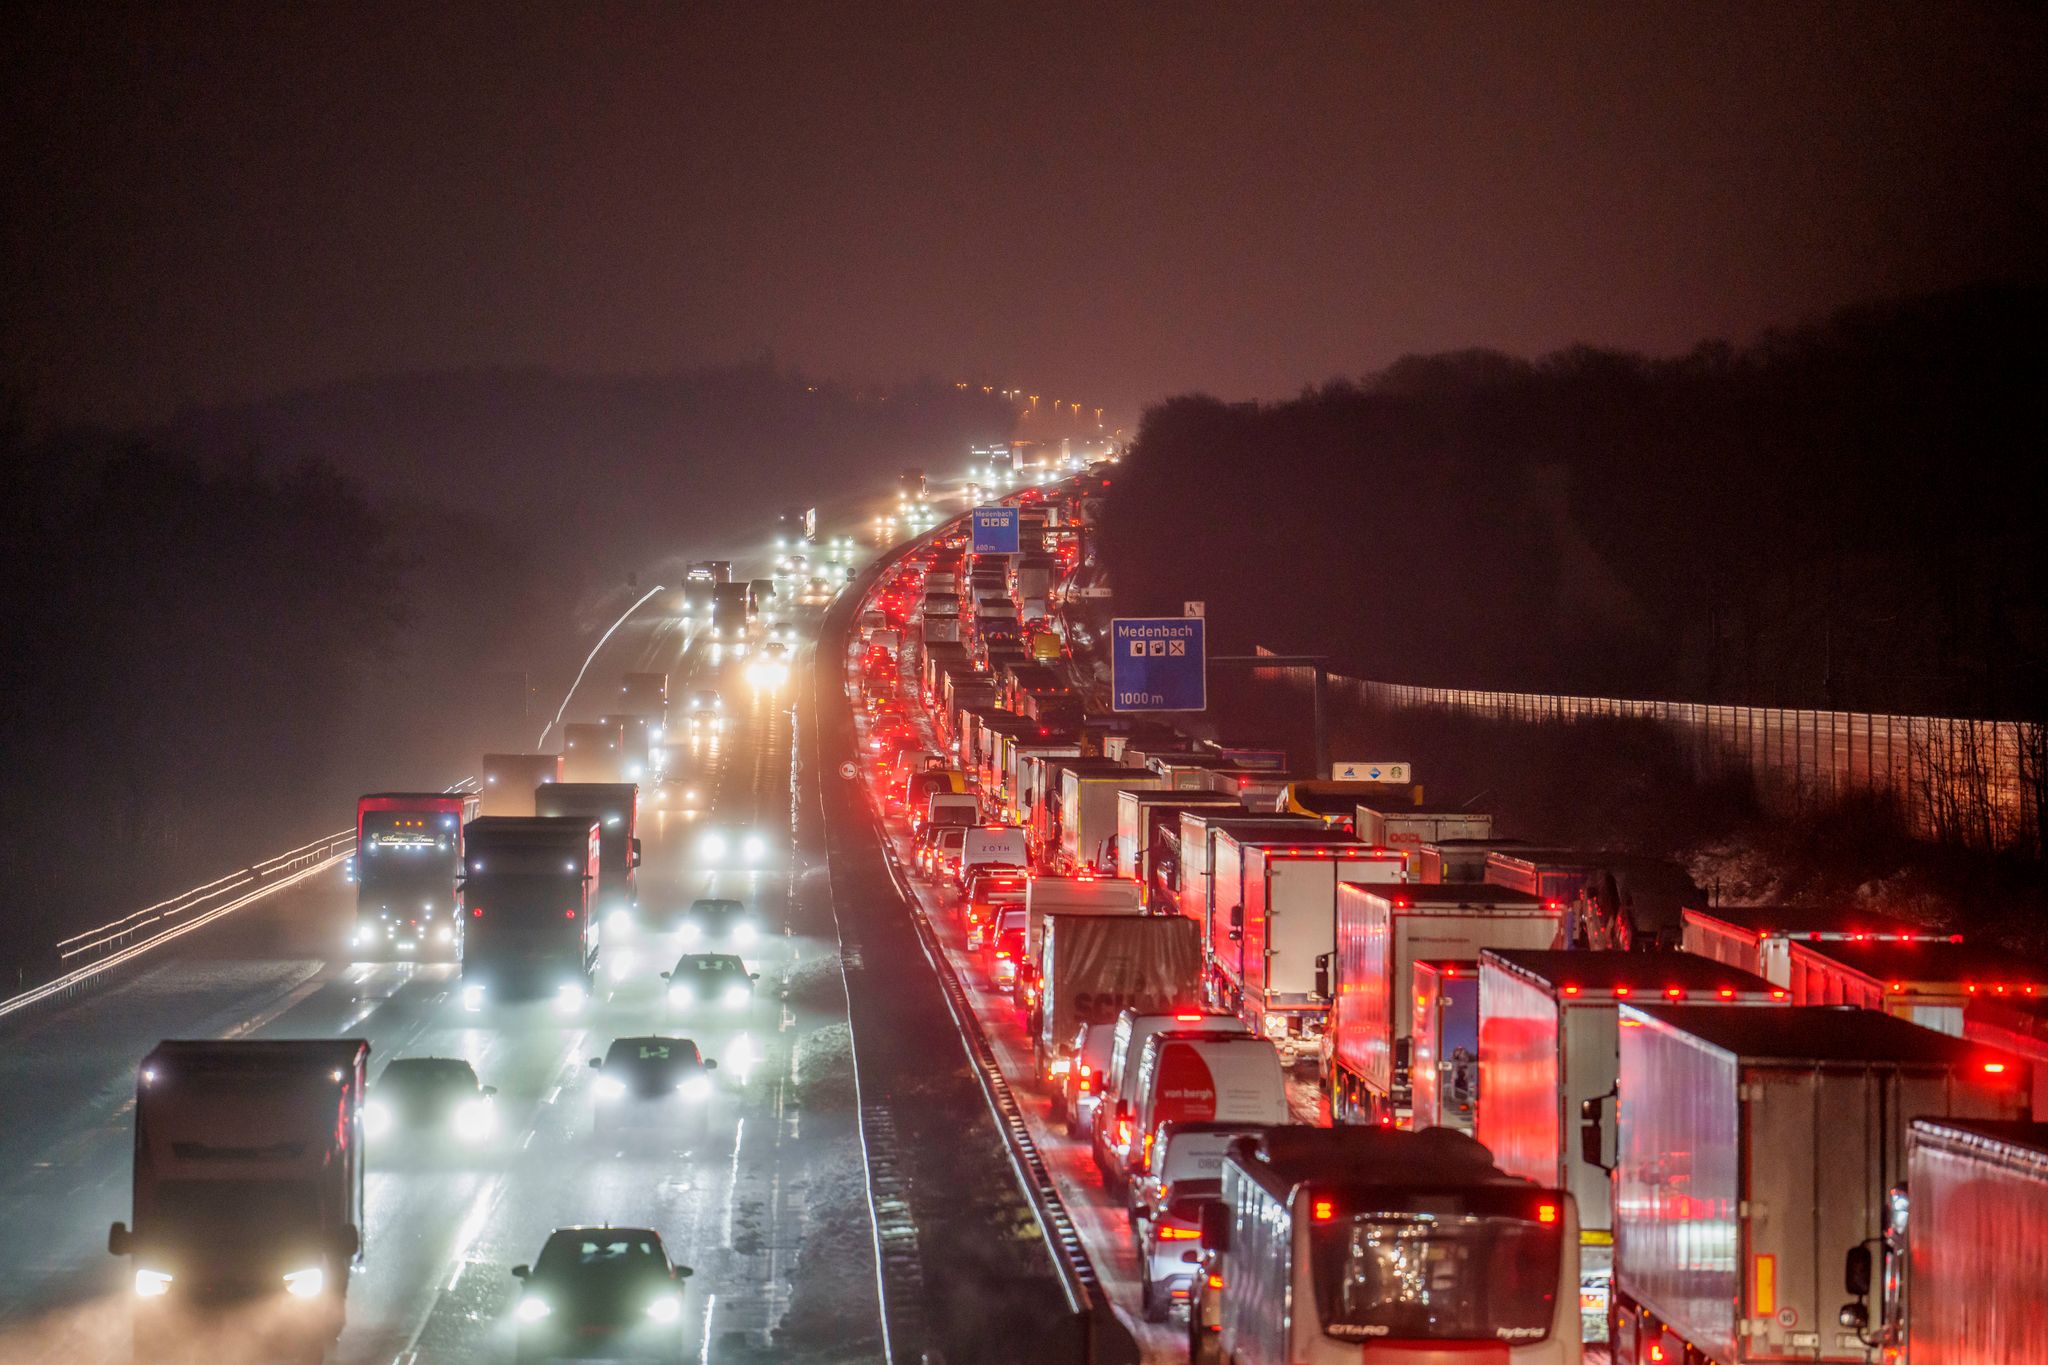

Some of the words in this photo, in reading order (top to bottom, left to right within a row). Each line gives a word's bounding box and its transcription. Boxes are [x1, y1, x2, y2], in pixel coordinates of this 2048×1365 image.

[1118, 625, 1193, 637] Medenbach
[1119, 693, 1149, 704] 1000
[1151, 695, 1163, 704] m
[1164, 1089, 1182, 1098] von
[1496, 1327, 1546, 1339] hybrid
